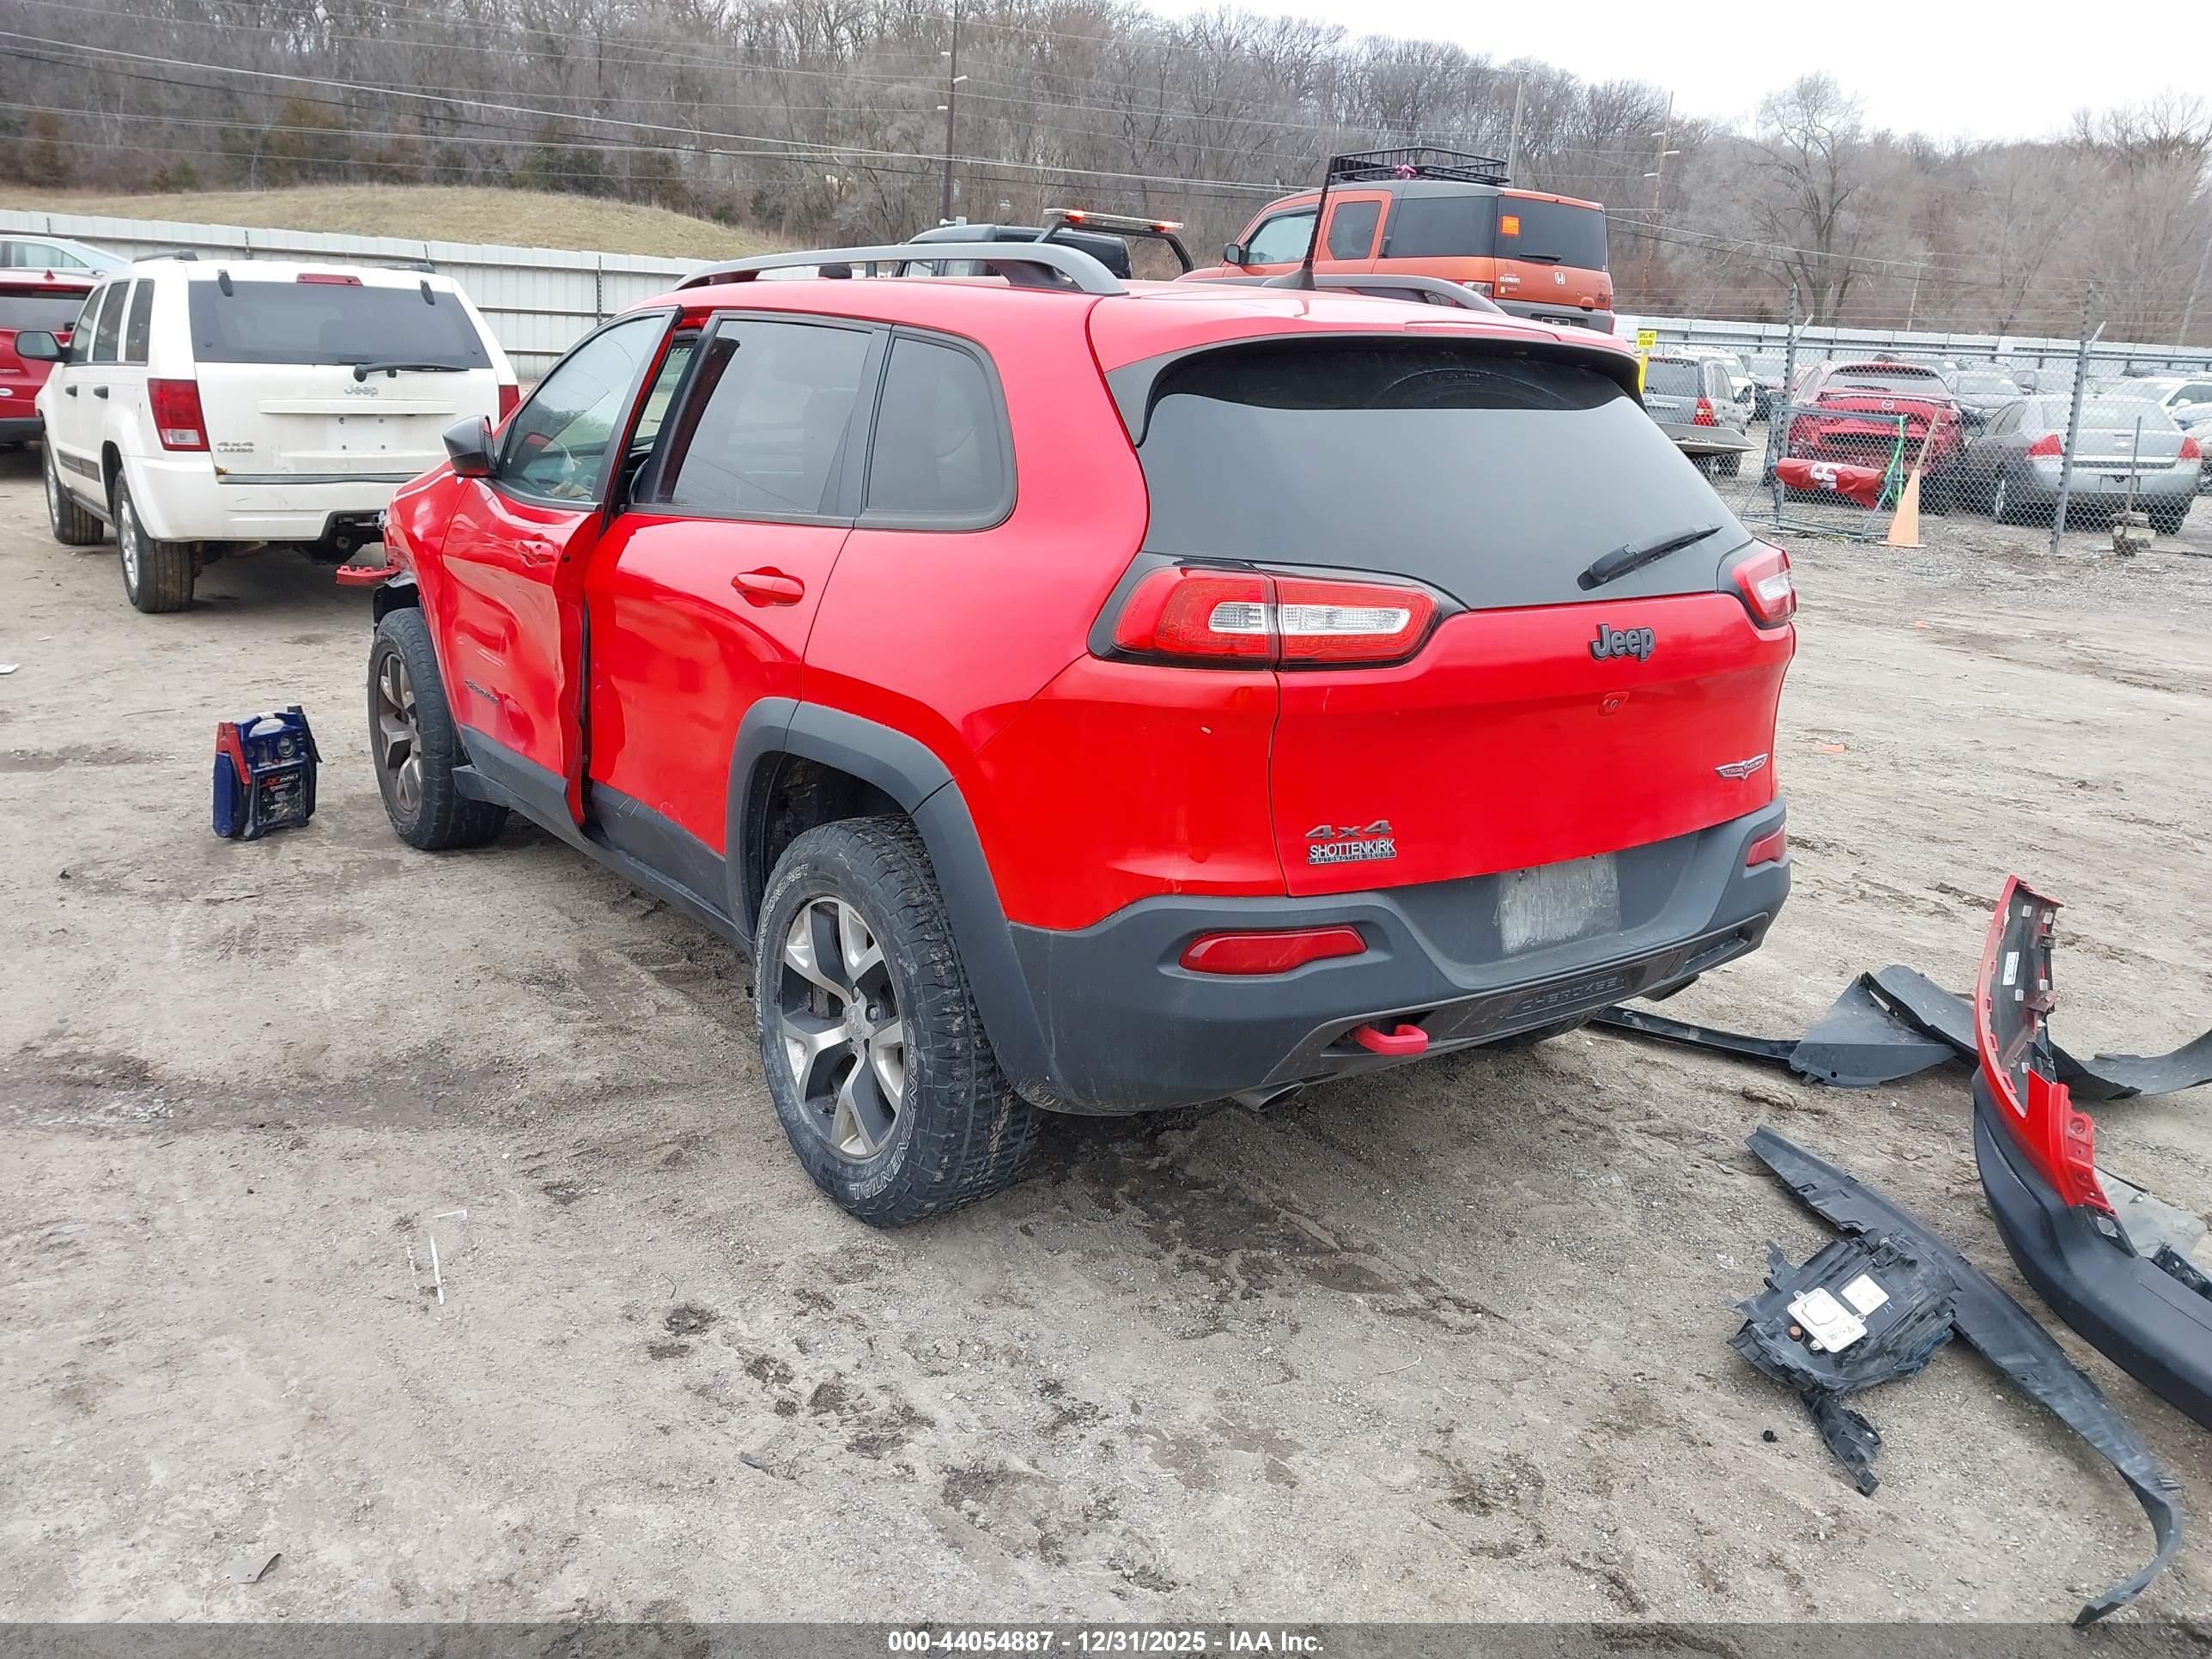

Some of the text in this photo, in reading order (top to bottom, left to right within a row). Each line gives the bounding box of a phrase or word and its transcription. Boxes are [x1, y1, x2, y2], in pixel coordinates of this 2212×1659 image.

[343, 384, 379, 398] Jeep
[1590, 623, 1656, 660] Jeep
[1304, 819, 1393, 840] 4x4
[1309, 838, 1395, 859] SHOTTENKIRK
[1315, 851, 1392, 864] AUTOMOTIVE GROUP
[1521, 976, 1619, 1010] CHEROKEE
[849, 1019, 918, 1200] CONTINENTAL
